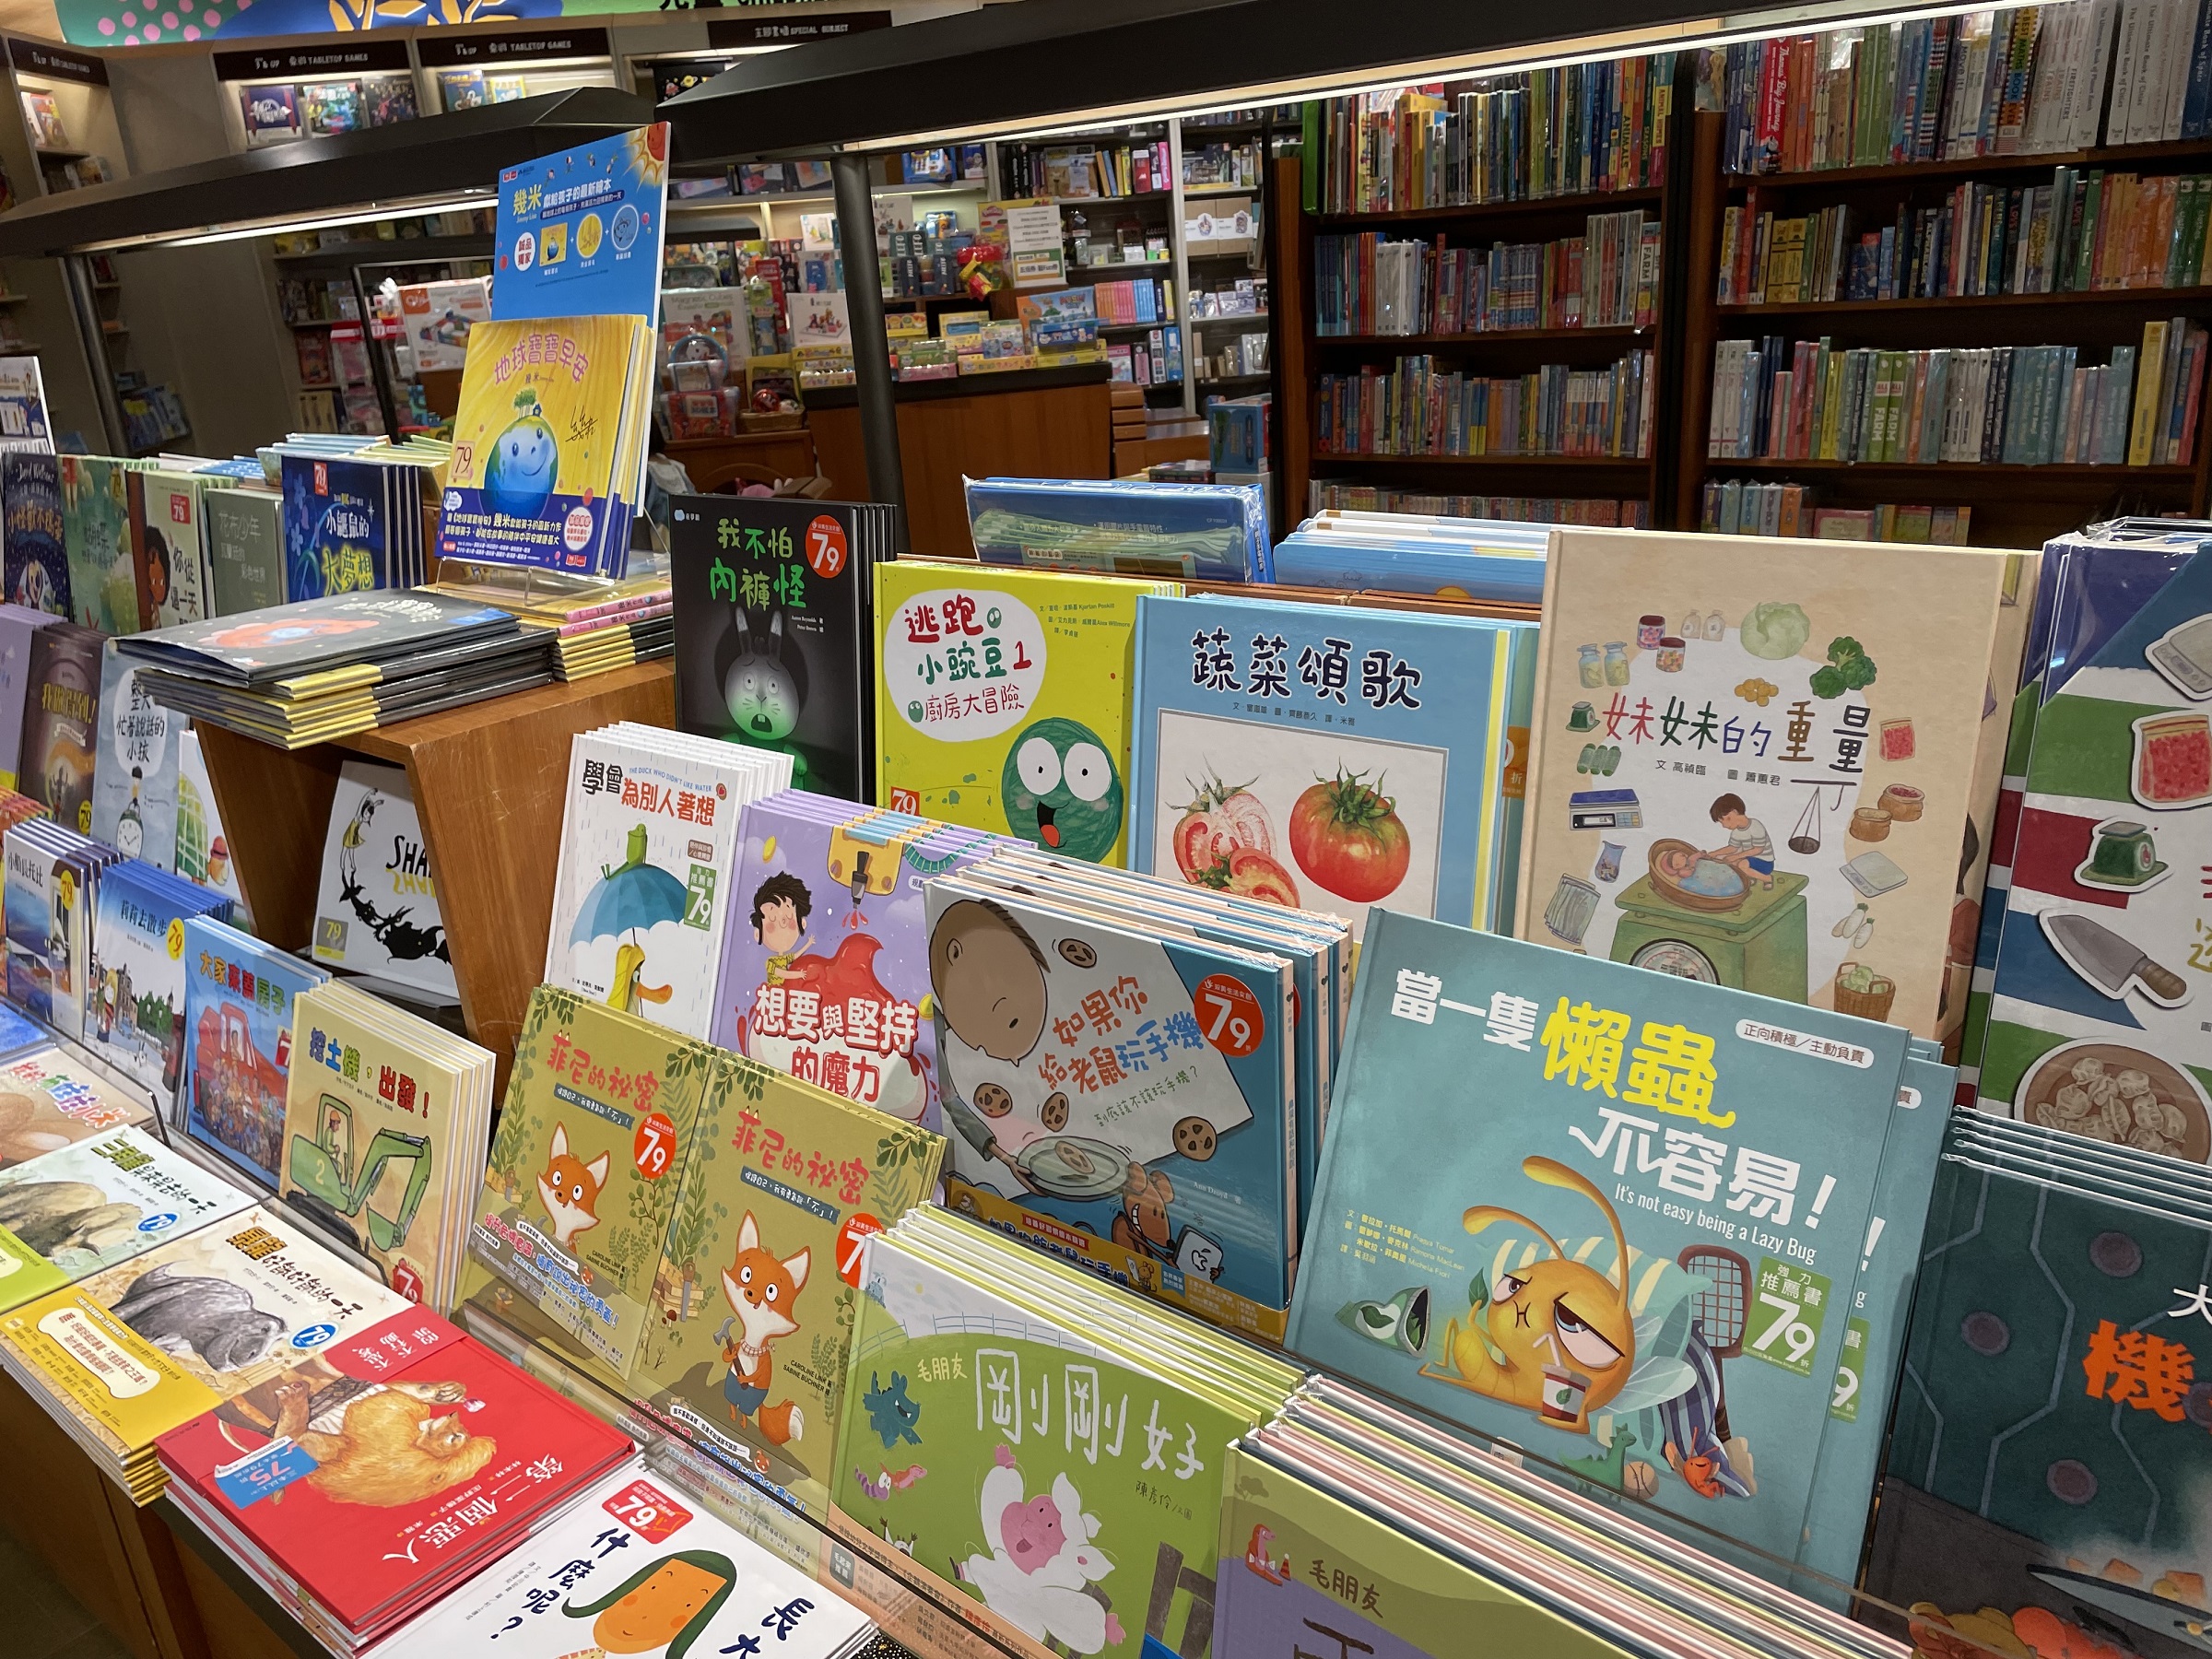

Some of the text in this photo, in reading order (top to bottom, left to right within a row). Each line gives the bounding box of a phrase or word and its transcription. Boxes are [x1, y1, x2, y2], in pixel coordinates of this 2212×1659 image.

[2010, 73, 2022, 103] BOOK
[513, 183, 543, 217] 幾米
[1641, 246, 1652, 283] FARM
[494, 333, 590, 386] 地球寶寶早安
[1872, 407, 1885, 441] FARM
[454, 446, 473, 475] 79
[173, 506, 185, 522] 79
[717, 517, 794, 560] 我不怕
[812, 533, 841, 572] 79
[323, 548, 374, 597] 大夢想
[710, 556, 807, 612] 內褲怪
[904, 594, 984, 643] 逃跑
[1192, 627, 1422, 710] 蔬菜頌歌
[924, 684, 1026, 724] 廚房大冒險
[1602, 692, 1872, 774] 妹妹的重量
[582, 759, 623, 795] 學會
[638, 767, 652, 776] DUCK
[653, 769, 666, 779] WHO
[694, 782, 712, 793] WATER
[1655, 759, 1666, 771] 文
[80, 809, 92, 828] 79
[620, 777, 716, 827] 為別人著想
[891, 788, 919, 813] 79
[385, 834, 432, 878] SHA
[61, 879, 74, 903] 79
[688, 885, 712, 924] 79
[168, 923, 183, 953] 79
[326, 921, 342, 941] 79
[200, 949, 295, 1017] 大家來蓋房子
[755, 984, 918, 1057] 想要與堅持
[1052, 974, 1148, 1048] 如果你
[1205, 993, 1251, 1049] 79
[1037, 1009, 1205, 1096] 給老鼠玩手機
[310, 1027, 430, 1119] 挖土機，出發！
[790, 1043, 880, 1102] 的魔力
[636, 1126, 666, 1173] 79
[1568, 1106, 1839, 1230] 不容易！
[315, 1159, 326, 1184] 2
[1615, 1182, 1818, 1265] It's not easy being a Lazy Bug
[1435, 1241, 1455, 1254] Tomar
[1759, 1270, 1824, 1307] 推薦書
[1751, 1291, 1817, 1363] 79
[783, 1364, 802, 1379] SABINE
[790, 1359, 816, 1378] CAROLINE
[917, 1352, 969, 1382] 毛朋友
[1800, 1358, 1810, 1369] 折
[975, 1347, 1205, 1480] 剛剛好
[249, 1460, 291, 1487] 75
[382, 1453, 564, 1564] 第二個惡人
[615, 1494, 658, 1527] 79
[489, 1527, 632, 1641] 什麼呢？
[1309, 1559, 1383, 1619] 毛朋友
